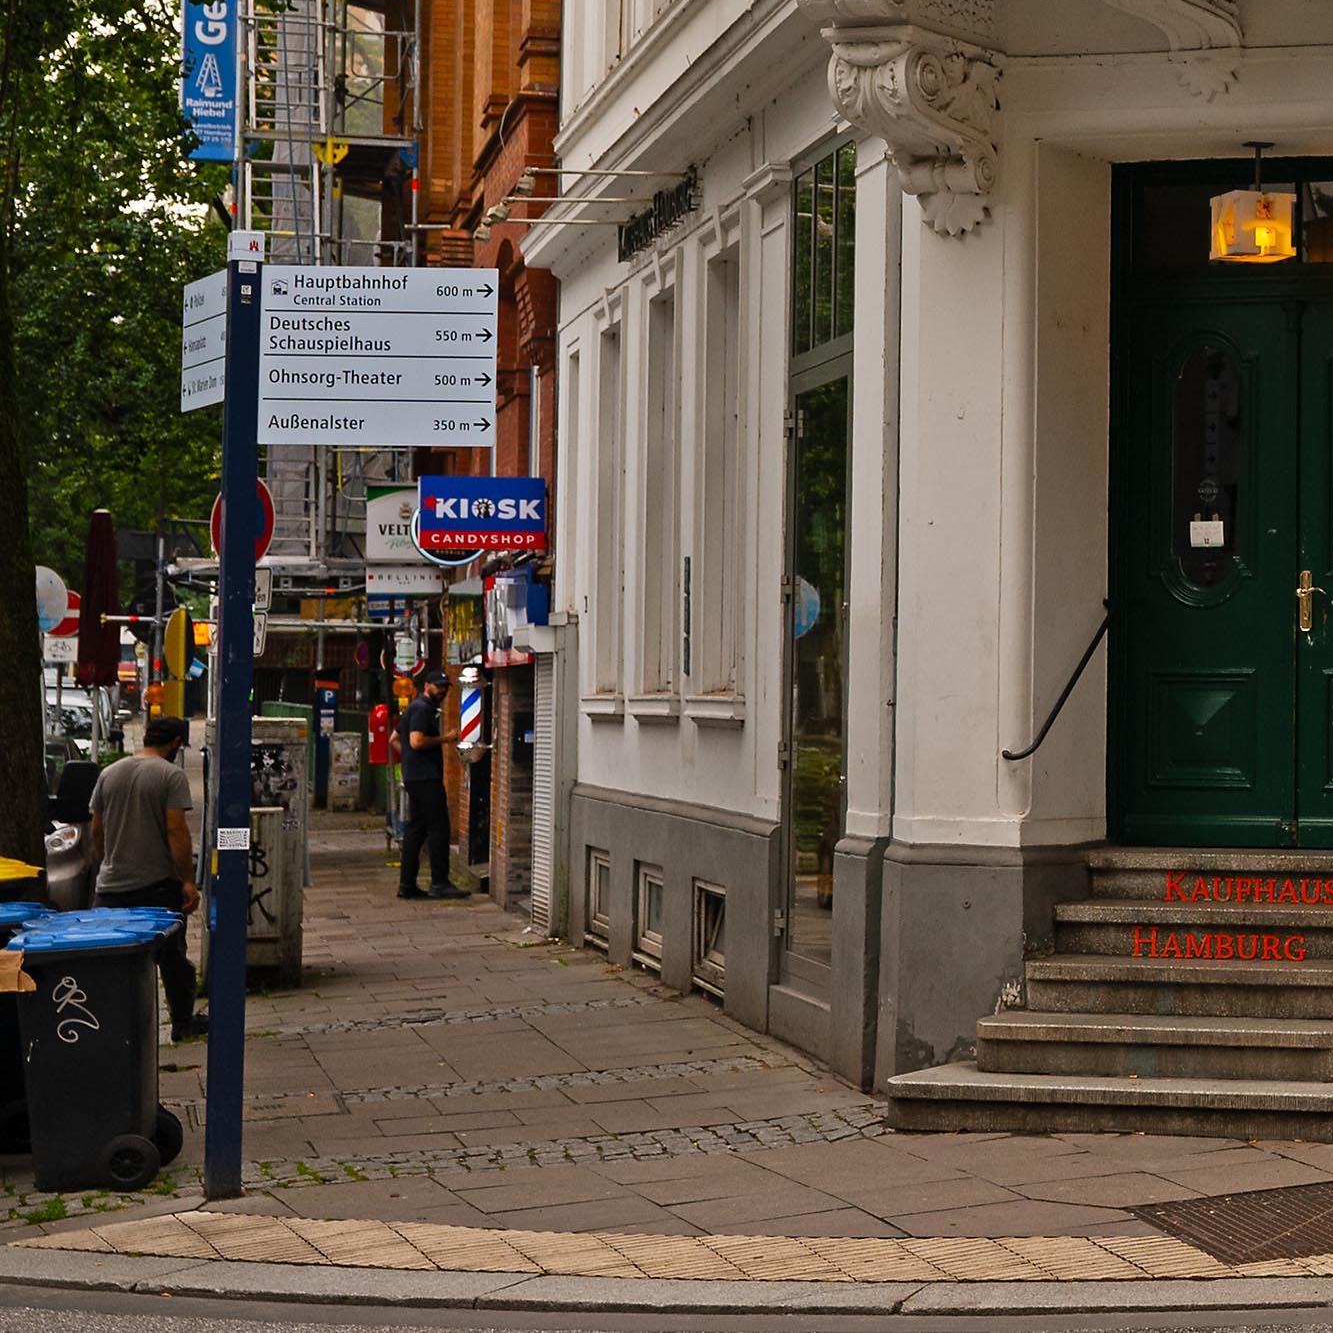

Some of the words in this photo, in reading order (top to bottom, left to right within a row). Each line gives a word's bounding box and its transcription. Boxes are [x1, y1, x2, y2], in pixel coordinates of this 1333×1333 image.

[186, 98, 233, 109] Raimund
[192, 107, 225, 117] Hiebel
[294, 274, 409, 292] Hauptbahnhof
[436, 286, 459, 297] 600
[462, 289, 473, 297] m
[293, 294, 336, 306] Central
[339, 295, 381, 307] Station
[269, 316, 351, 332] Deutsches
[435, 330, 458, 342] 550
[461, 333, 472, 342] m
[269, 335, 392, 354] Schauspielhaus
[268, 369, 403, 388] Ohnsorg-Theater
[434, 374, 457, 386] 500
[460, 377, 471, 386] m
[268, 415, 365, 430] Außenalster
[433, 419, 456, 431] 350
[459, 422, 470, 431] m
[434, 497, 542, 521] KIOSK
[378, 524, 412, 536] VELT
[431, 533, 536, 545] CANDYSHOP
[1131, 925, 1307, 962] HAMBURG
